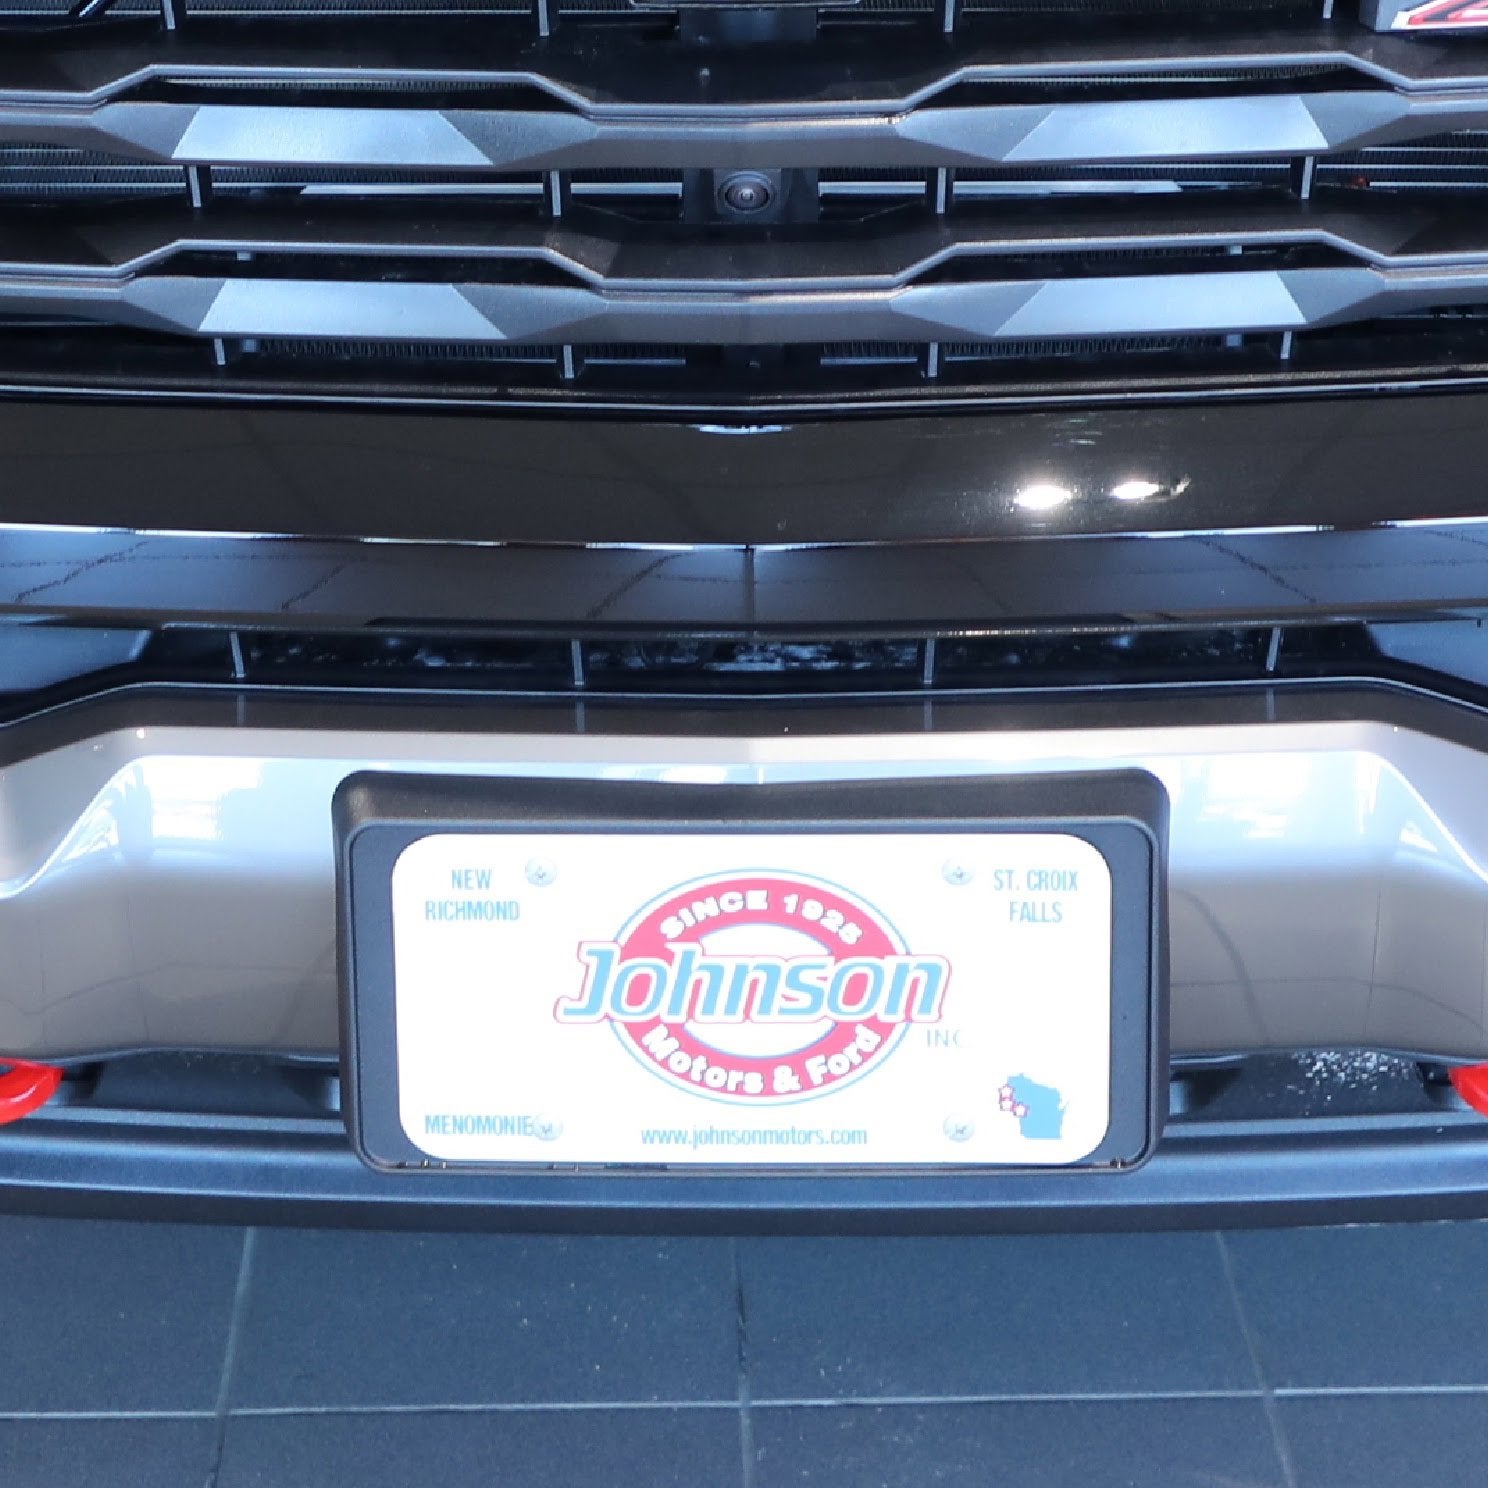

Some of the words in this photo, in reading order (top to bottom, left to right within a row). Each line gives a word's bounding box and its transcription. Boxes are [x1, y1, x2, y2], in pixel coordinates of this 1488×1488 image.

[450, 869, 493, 890] NEW
[993, 868, 1020, 892] ST.
[1026, 868, 1079, 892] CROIX
[424, 900, 521, 921] RICHMOND
[659, 889, 769, 941] SINCE
[783, 893, 863, 945] 1925
[1009, 901, 1063, 923] FALLS
[558, 944, 948, 1020] Johnson
[641, 1023, 764, 1094] Motors
[772, 1065, 802, 1094] &
[805, 1022, 883, 1085] Ford
[424, 1114, 534, 1137] MENOMONIE
[640, 1124, 868, 1151] www.johnsonmotors.com
